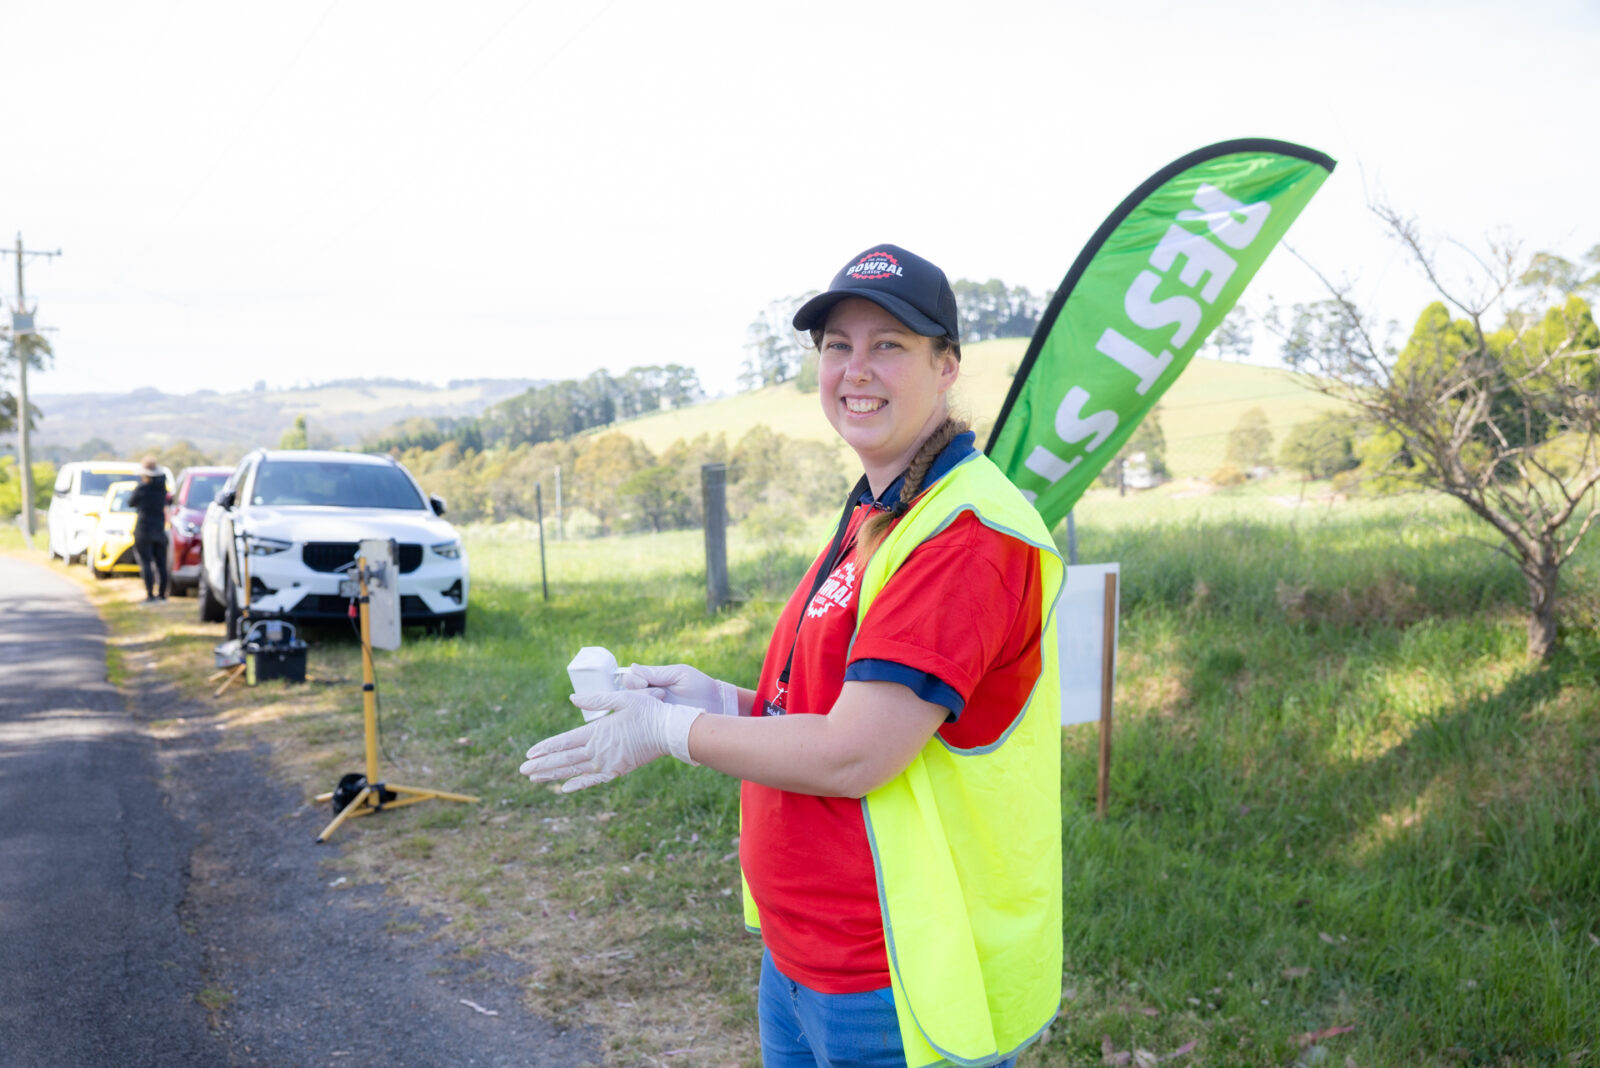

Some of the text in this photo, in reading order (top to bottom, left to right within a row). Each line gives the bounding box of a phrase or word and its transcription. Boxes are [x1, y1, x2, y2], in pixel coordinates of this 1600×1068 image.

[846, 261, 903, 277] BOWRAL
[1018, 183, 1272, 506] REST ST
[817, 578, 853, 608] WRAL
